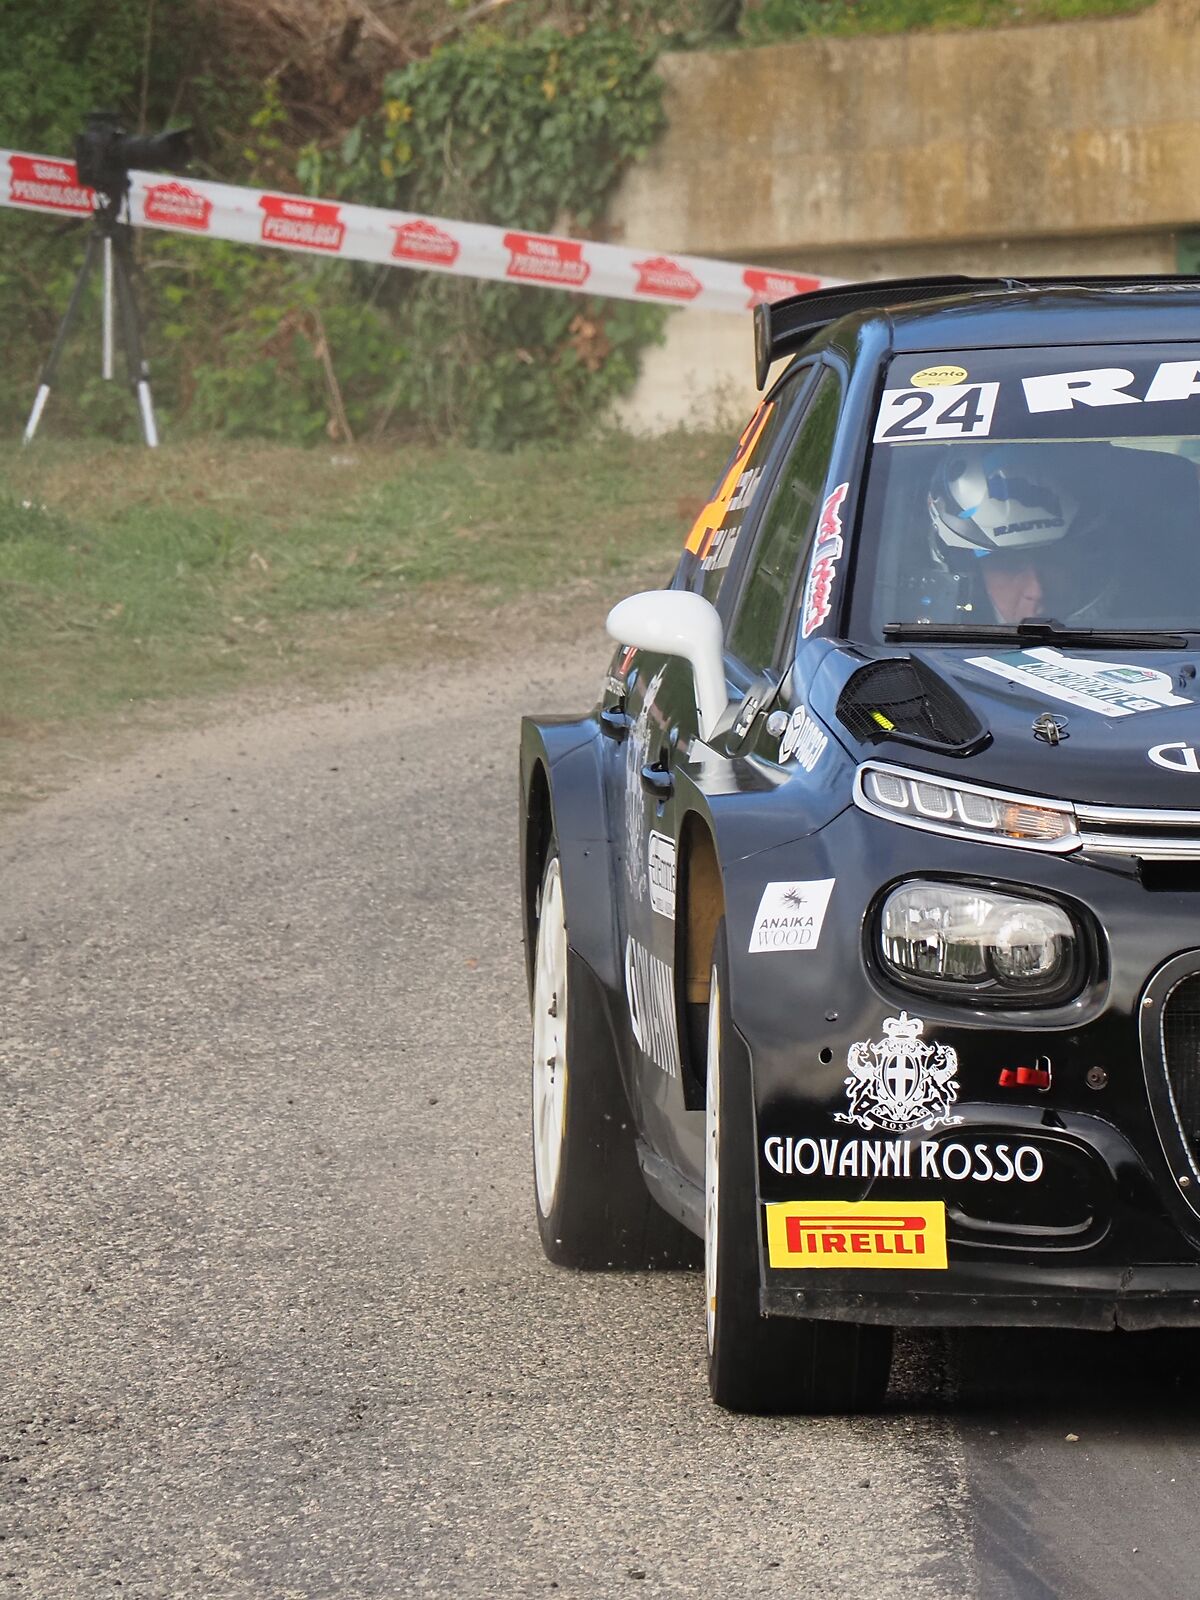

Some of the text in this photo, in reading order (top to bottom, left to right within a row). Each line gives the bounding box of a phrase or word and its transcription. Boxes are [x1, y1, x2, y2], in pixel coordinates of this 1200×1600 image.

[882, 387, 985, 438] 24
[758, 929, 812, 947] WOOD
[760, 916, 814, 930] ANAIKA
[764, 1136, 1043, 1183] GIOVANNI ROSSO
[785, 1216, 927, 1255] PIRELLI
